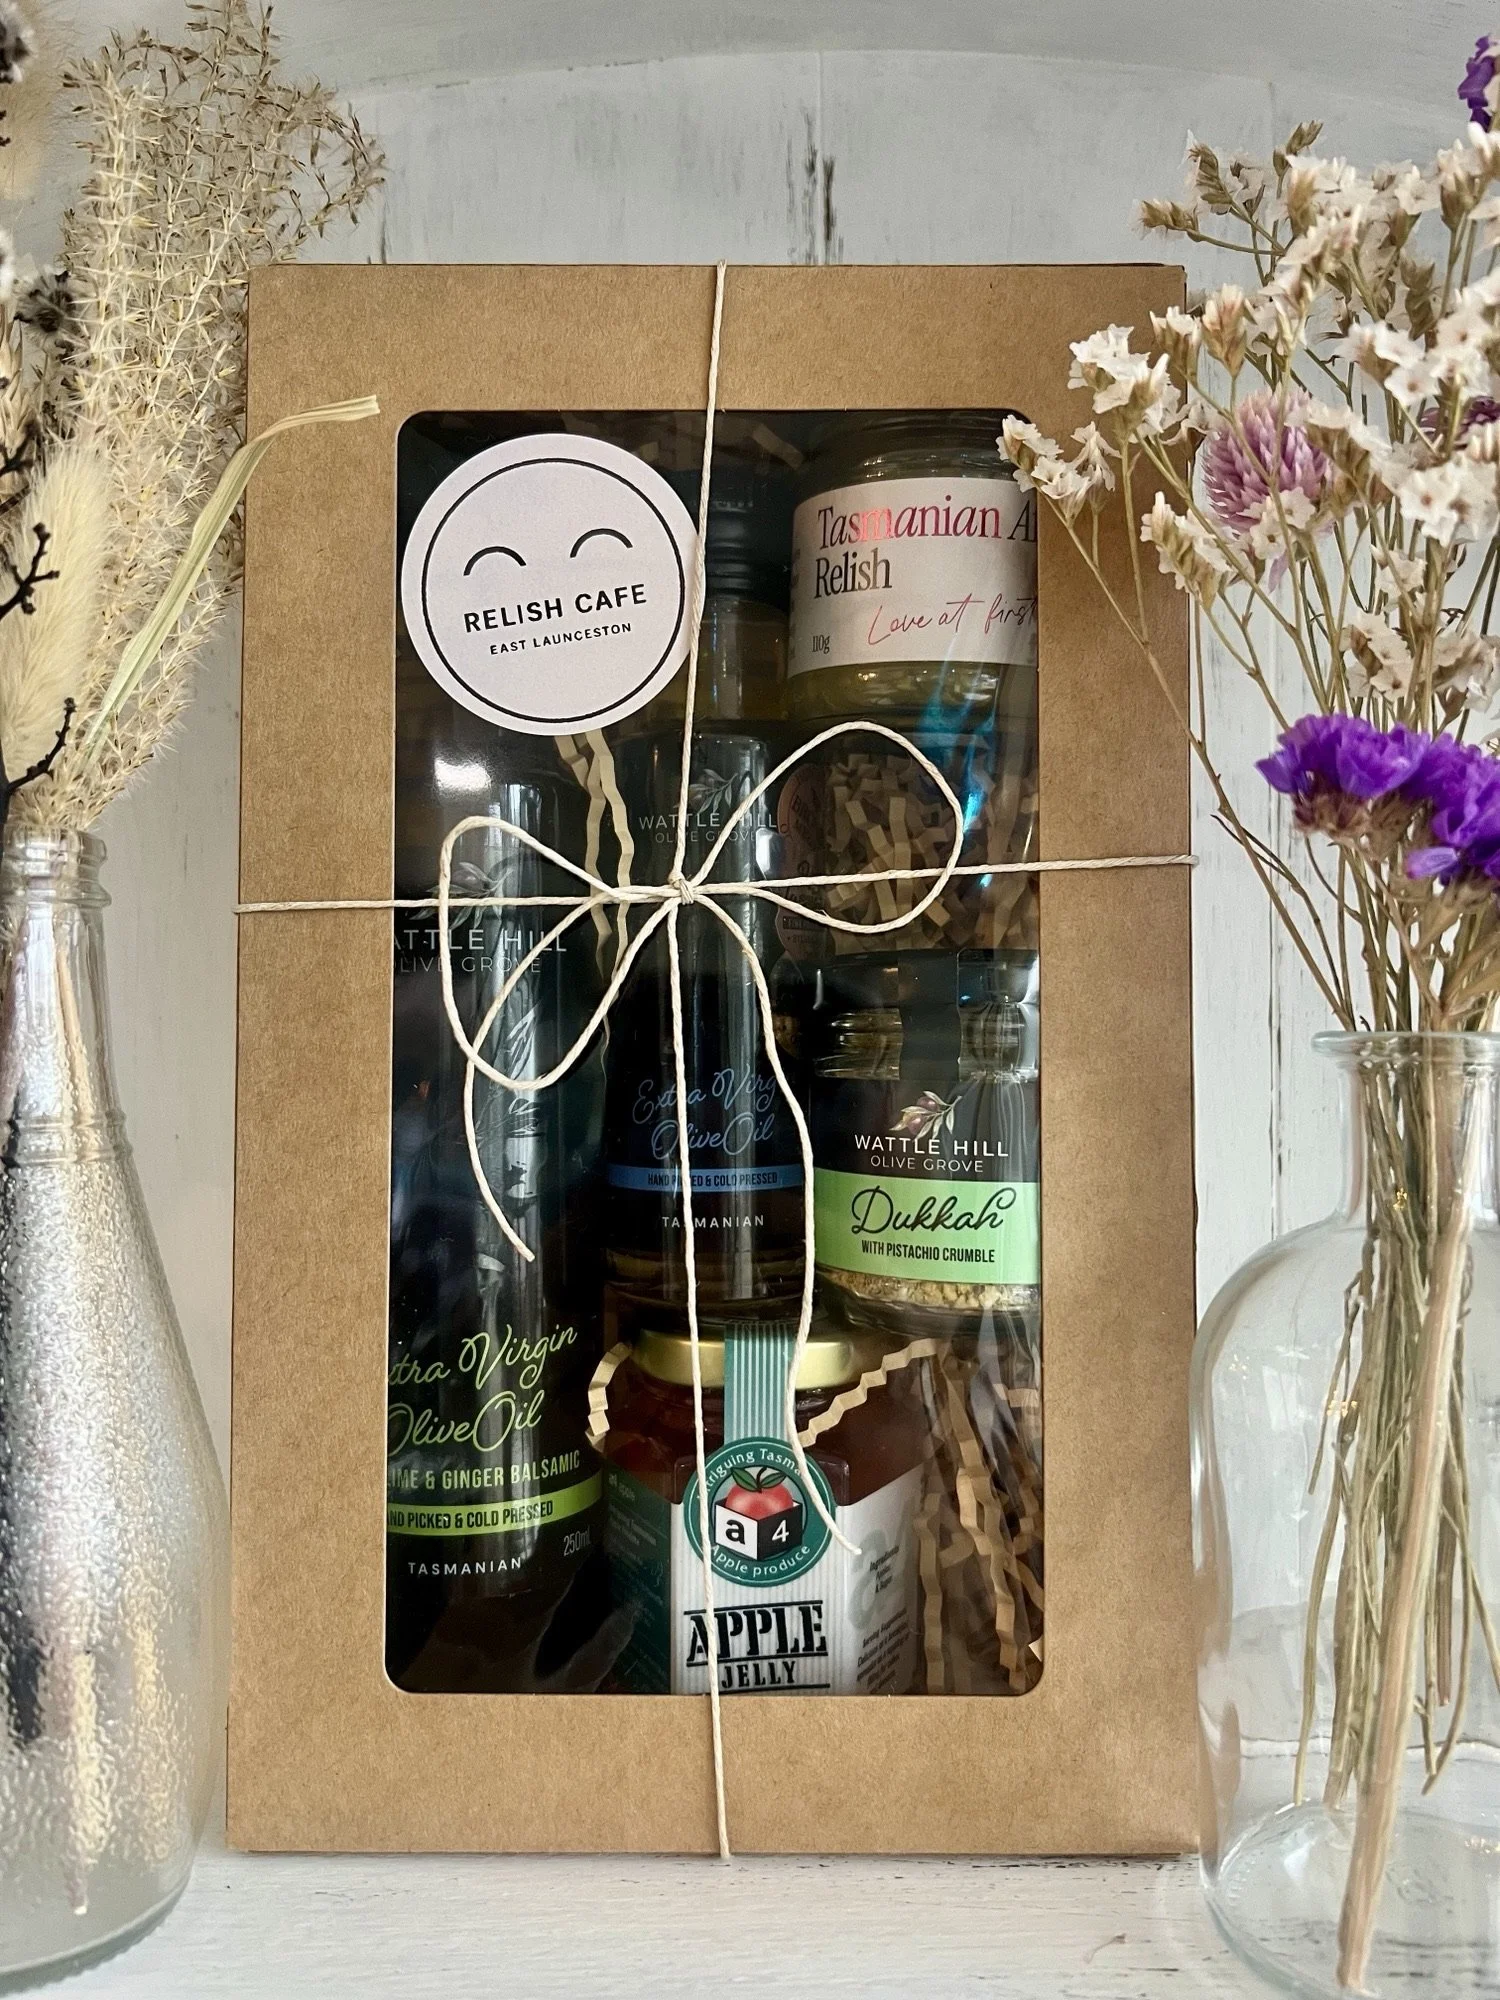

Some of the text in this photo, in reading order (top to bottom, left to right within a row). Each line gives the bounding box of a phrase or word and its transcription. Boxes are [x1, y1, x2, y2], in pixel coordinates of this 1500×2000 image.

[818, 495, 1002, 550] Tasmanian
[814, 547, 892, 599] Relish
[463, 583, 647, 633] RELISH CAFE
[867, 605, 932, 646] Love
[938, 593, 985, 633] at
[489, 623, 632, 656] EAST LAUNCESTON
[812, 635, 830, 655] 110g
[655, 830, 698, 844] OLIE
[504, 929, 567, 952] HILL
[632, 1063, 776, 1124] Exta Virg
[723, 1112, 775, 1155] Oil
[854, 1134, 1009, 1157] WATTLE HILL
[648, 1173, 670, 1186] HAND
[705, 1174, 712, 1187] &
[714, 1174, 736, 1187] COLD
[739, 1172, 778, 1186] PRESSED
[870, 1155, 984, 1173] OLIVE GROVE
[662, 1215, 764, 1229] TAMANIAN
[851, 1185, 1017, 1235] Dukkah
[861, 1240, 995, 1263] WITH PISTACHIO CRUMBLE
[458, 1324, 579, 1391] Virgin
[472, 1389, 545, 1452] Oil
[388, 1450, 581, 1491] IME & GINGER BALSAMIC
[408, 1511, 451, 1529] PICKED
[455, 1511, 464, 1529] &
[466, 1509, 499, 1529] COLD
[502, 1500, 554, 1524] PRESSED
[725, 1519, 790, 1545] a 4
[408, 1556, 522, 1576] TASMANIAN
[711, 1545, 811, 1578] Apple produce
[686, 1604, 828, 1663] APPLE
[722, 1660, 796, 1690] JELLY
